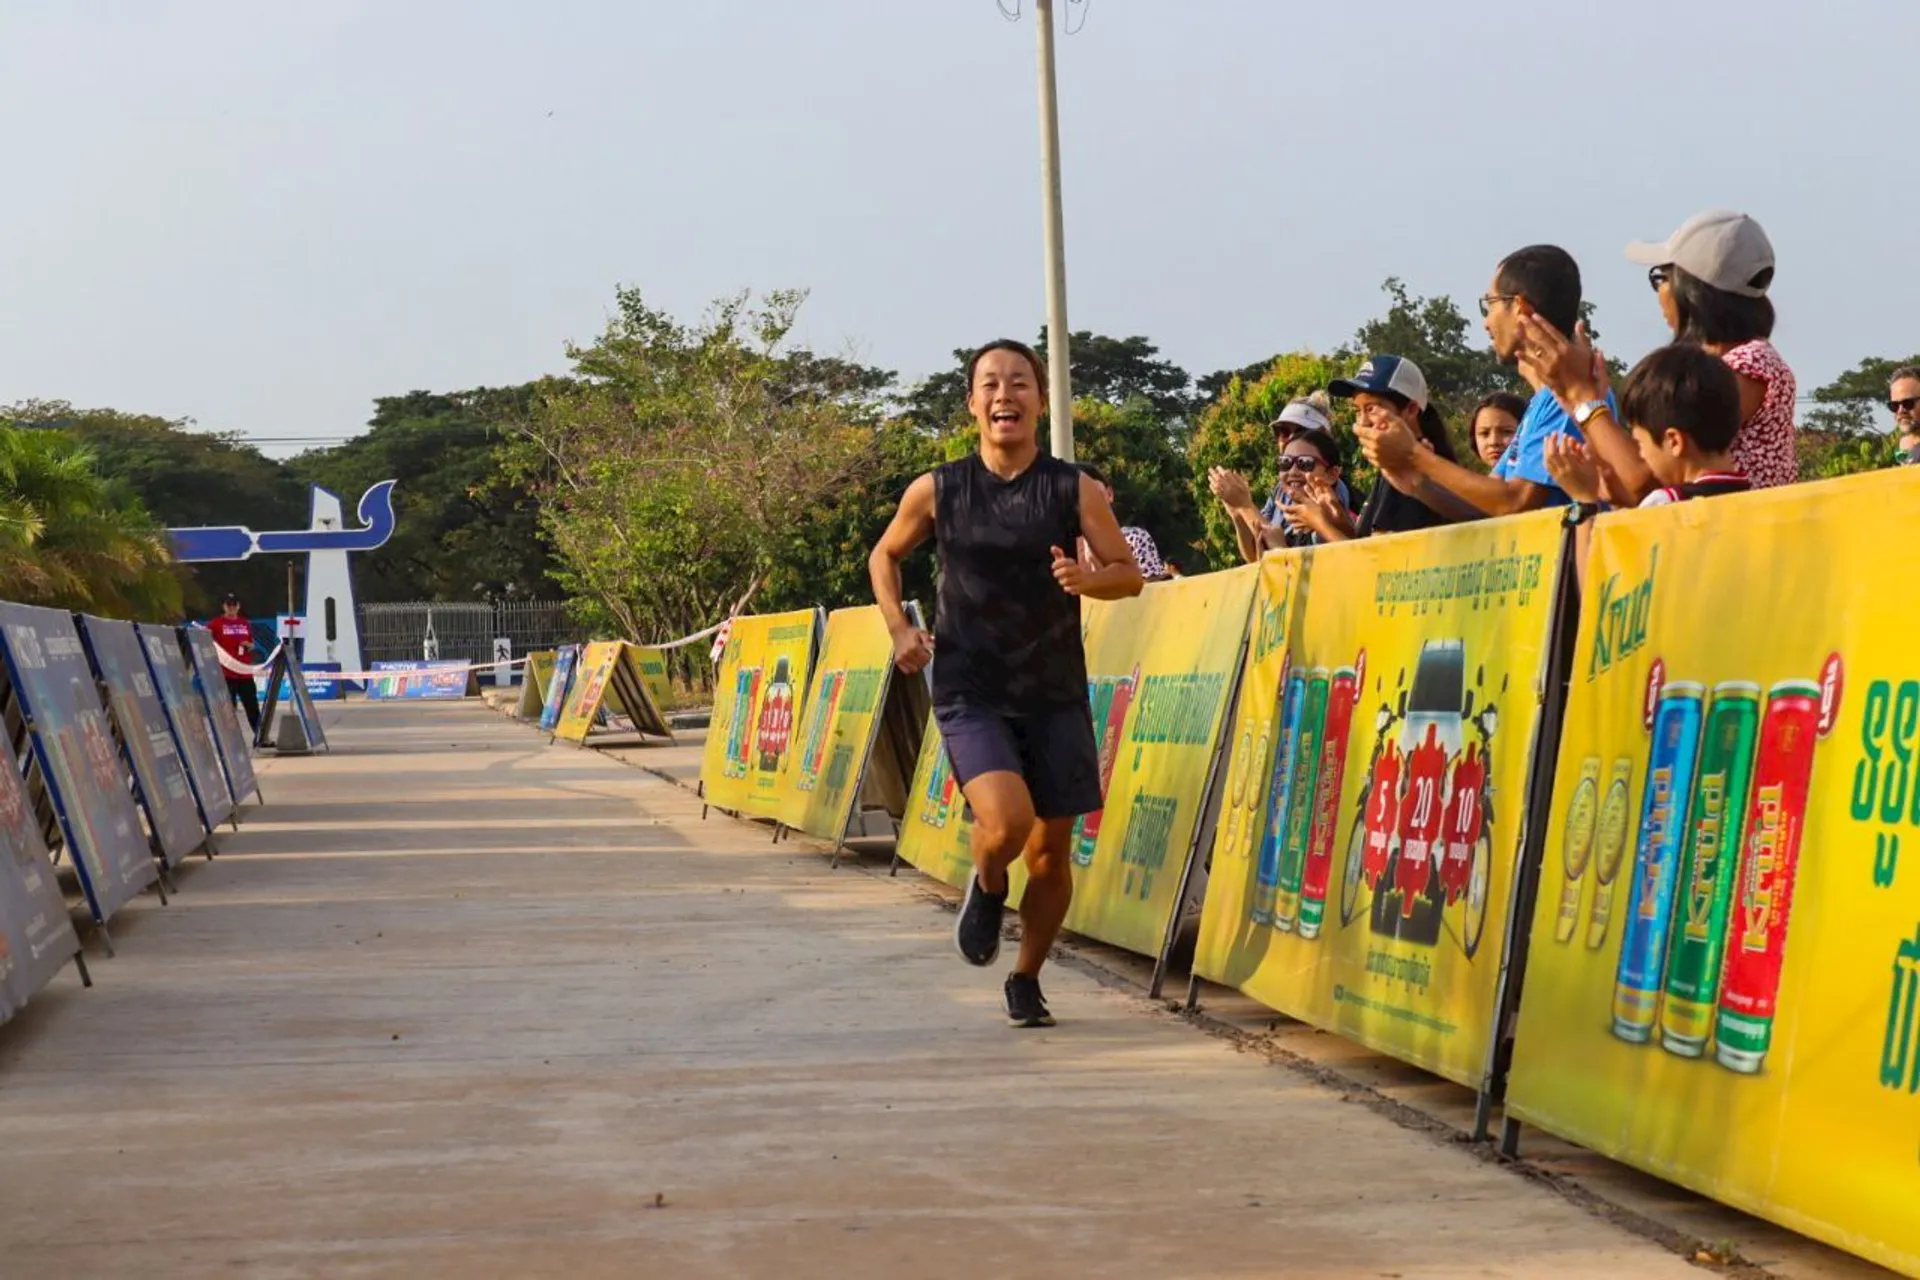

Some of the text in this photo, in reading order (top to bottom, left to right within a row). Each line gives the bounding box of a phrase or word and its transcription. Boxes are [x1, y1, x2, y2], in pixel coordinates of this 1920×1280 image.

[1587, 543, 1659, 682] Krud
[1376, 780, 1388, 822] 5
[1410, 776, 1433, 828] 20
[1457, 787, 1474, 834] 10
[1638, 764, 1673, 921] Krud
[1684, 767, 1726, 944] Krud
[1741, 780, 1784, 954] Krud
